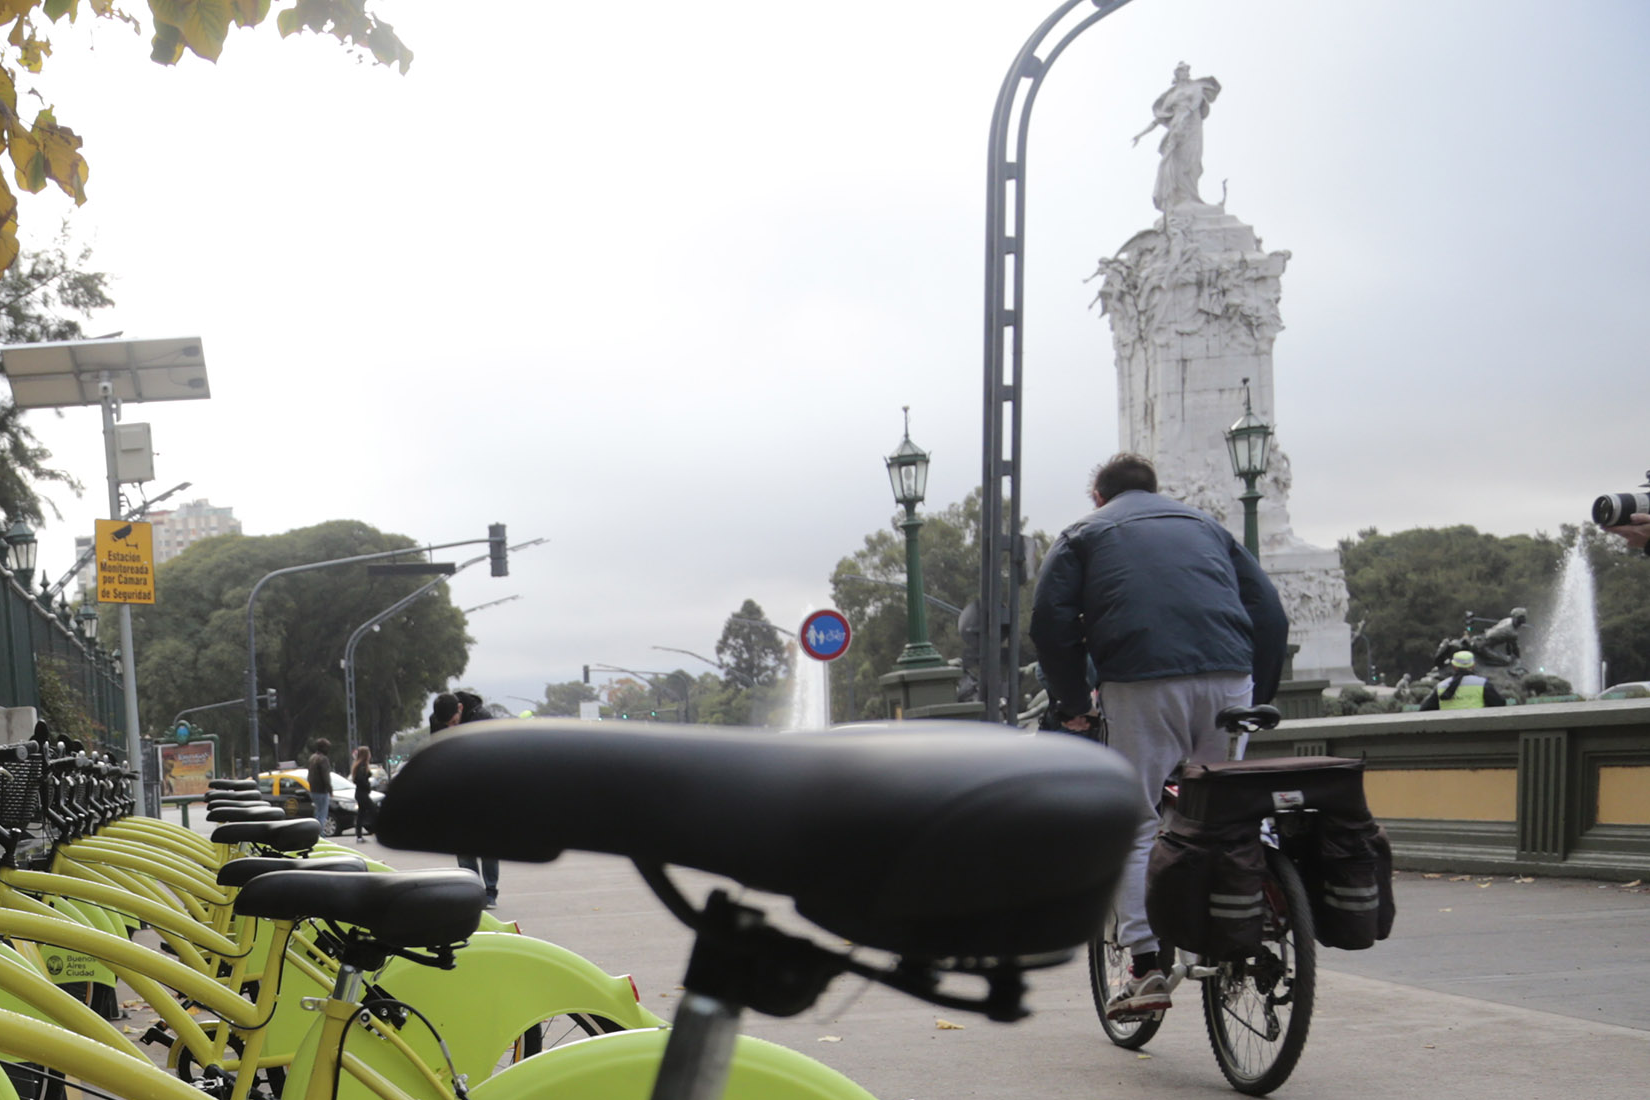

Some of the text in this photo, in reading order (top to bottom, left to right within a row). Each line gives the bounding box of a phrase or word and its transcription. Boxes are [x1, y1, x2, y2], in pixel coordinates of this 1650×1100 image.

[100, 561, 149, 575] Monitoreada
[102, 575, 115, 585] por
[101, 588, 151, 601] de Seguridad
[66, 962, 87, 970] Aires
[66, 969, 95, 977] Ciudad
